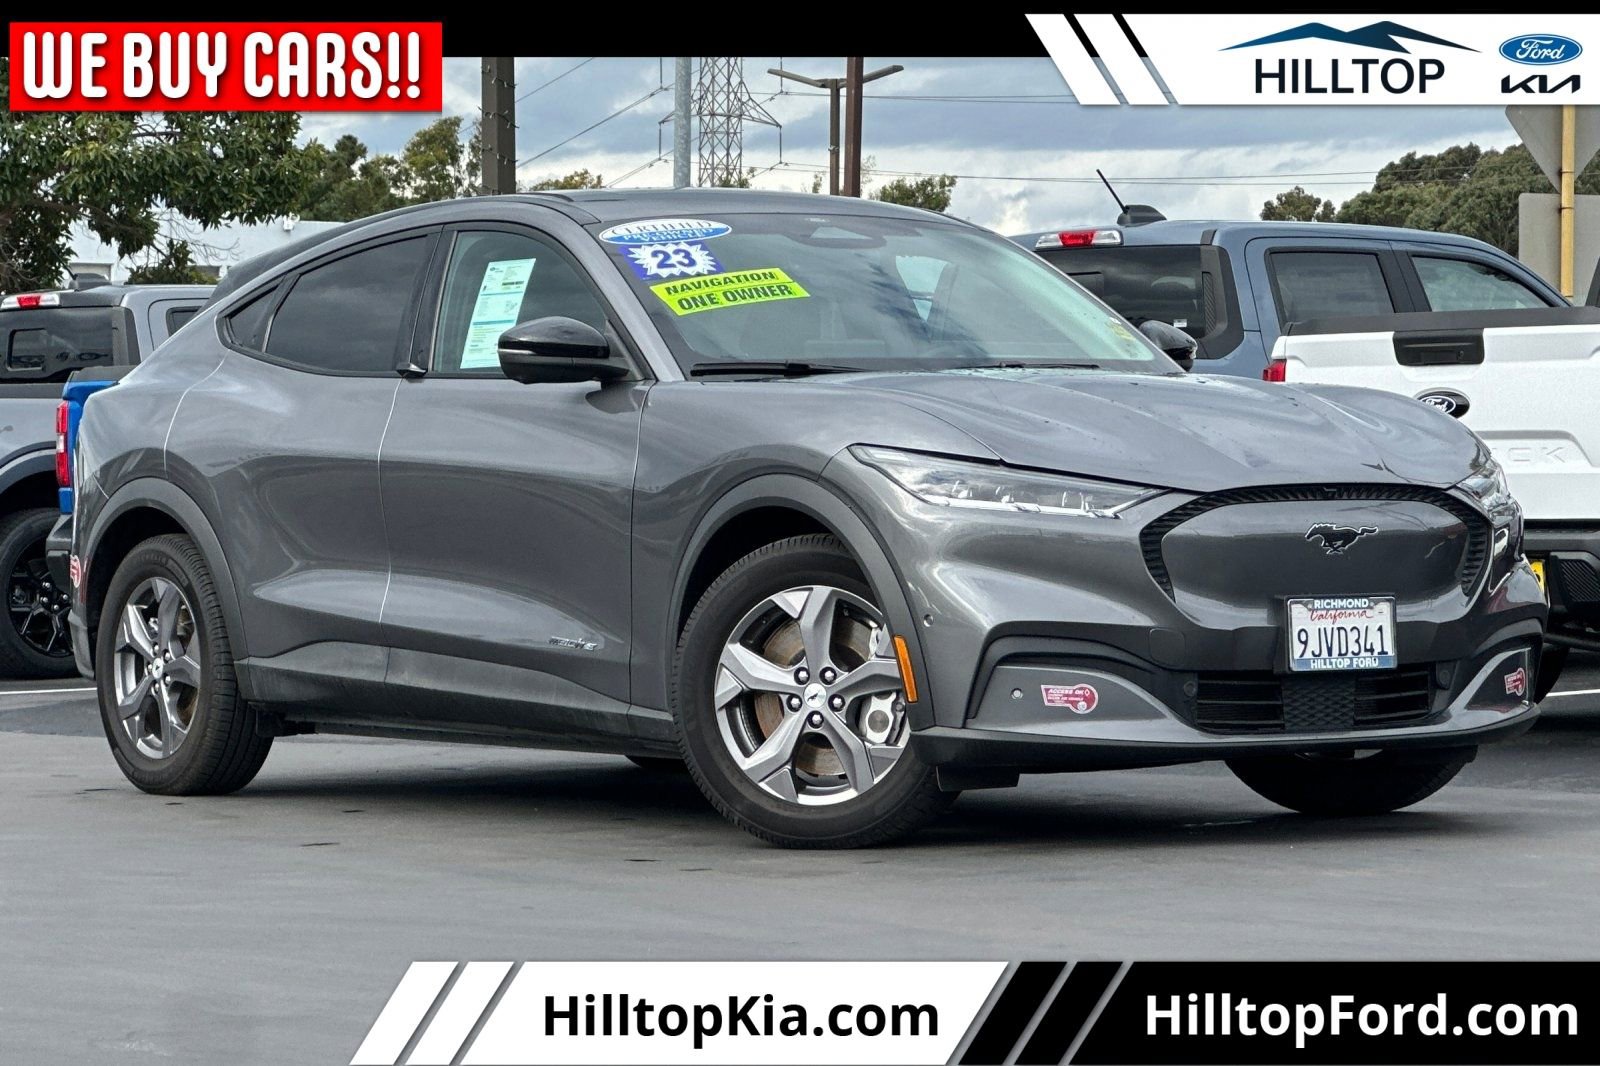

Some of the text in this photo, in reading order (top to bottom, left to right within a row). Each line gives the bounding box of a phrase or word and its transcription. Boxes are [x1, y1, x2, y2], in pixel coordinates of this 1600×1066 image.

[651, 248, 697, 269] 23
[665, 271, 775, 296] NAVIGATION
[677, 284, 792, 310] ONE OWNER
[1314, 599, 1369, 609] RICHMOND
[1310, 609, 1373, 624] California
[1297, 625, 1388, 658] 9JVD341
[1310, 657, 1379, 669] HILLTOP FORD
